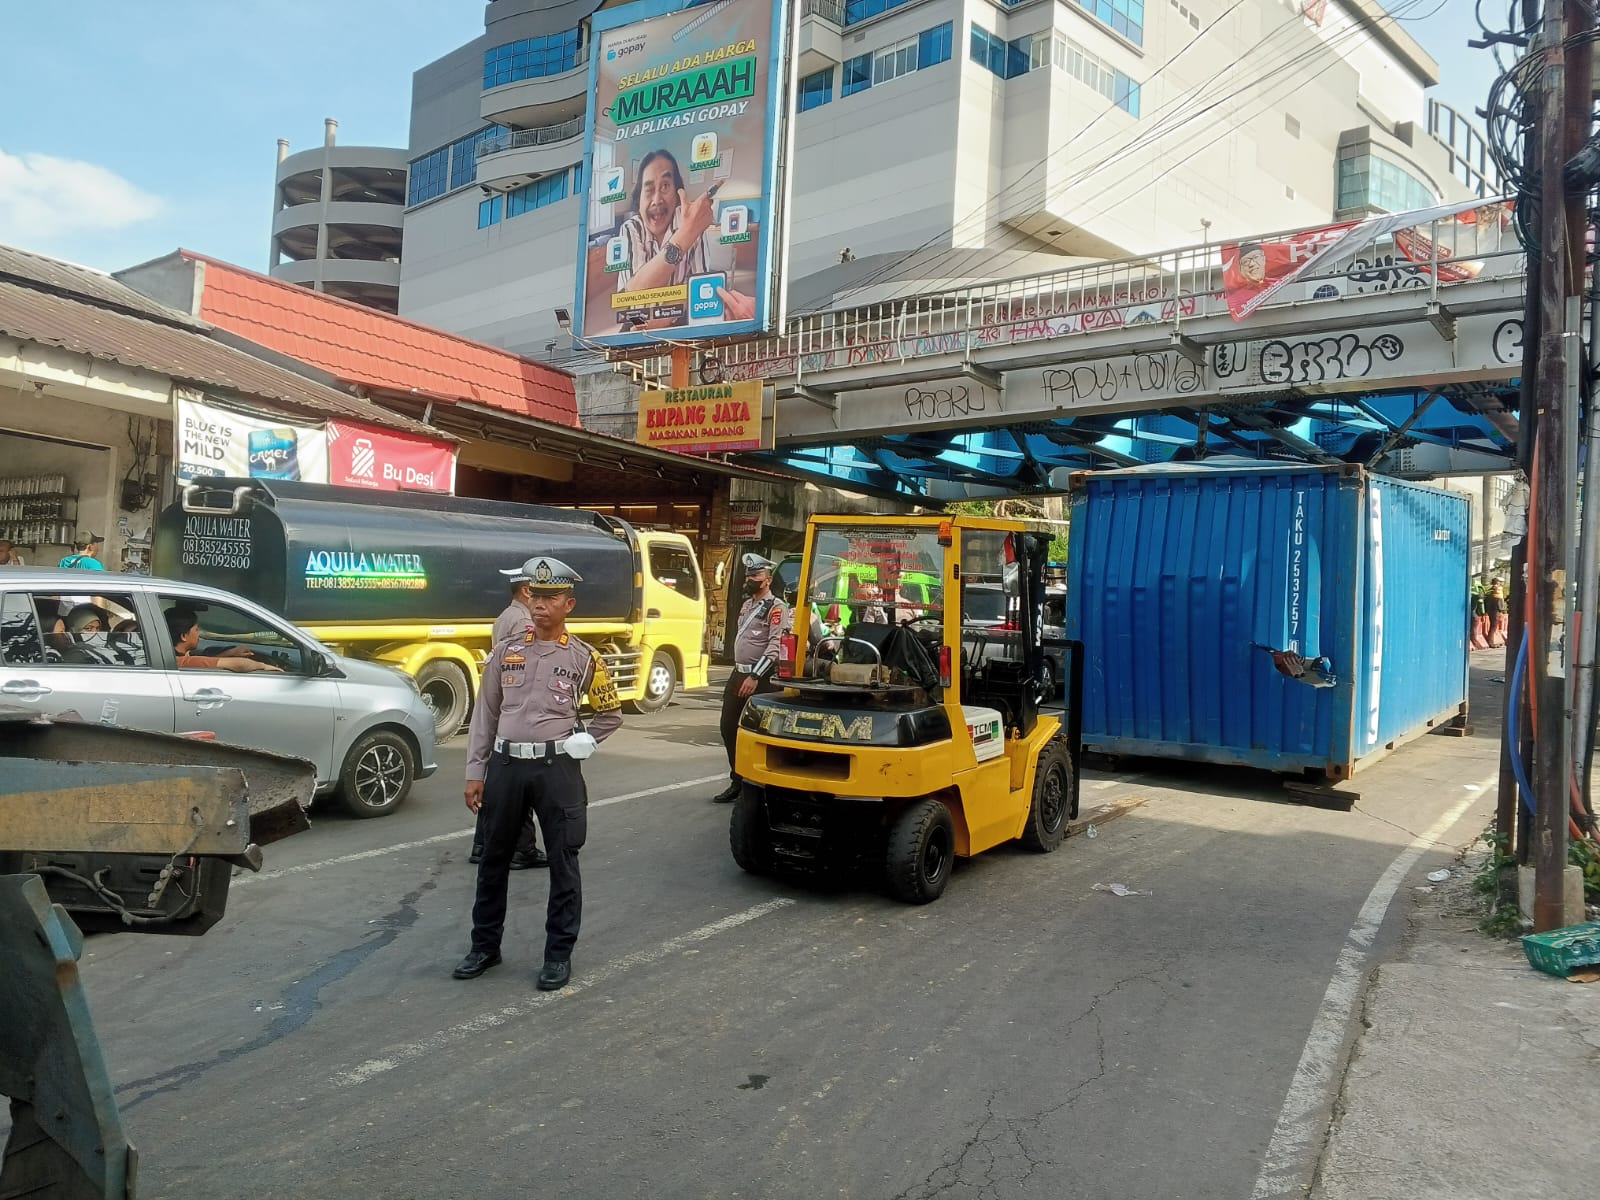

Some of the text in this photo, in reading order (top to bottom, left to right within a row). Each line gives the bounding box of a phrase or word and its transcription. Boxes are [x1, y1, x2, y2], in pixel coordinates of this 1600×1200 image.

[618, 42, 645, 58] gopay
[618, 39, 756, 91] SELALU ADA HARGA
[617, 61, 751, 121] MURAAAH
[615, 101, 749, 141] DI APLIKASI GOPAY
[616, 289, 682, 304] DOWNLOAD SEKARANG
[693, 300, 719, 312] gopay
[665, 385, 733, 403] RESTAURAN
[646, 401, 751, 428] EMPANG JAYA
[185, 417, 232, 437] BLUE IS
[649, 425, 745, 441] MASAKAN PADANG
[184, 429, 230, 447] THE NEW
[184, 440, 225, 460] MILD
[249, 448, 289, 464] CAMEL
[383, 463, 435, 487] Bu Desi
[184, 516, 251, 538] AQUILA WATER
[1294, 491, 1305, 545] TAKU
[183, 538, 251, 556] 081385245555
[182, 552, 250, 569] 08567092800
[305, 550, 426, 574] AQUILA WATER
[1291, 550, 1301, 635] 253257
[501, 663, 526, 672] SAEIN
[756, 705, 873, 740] TCM
[974, 721, 992, 736] TCM
